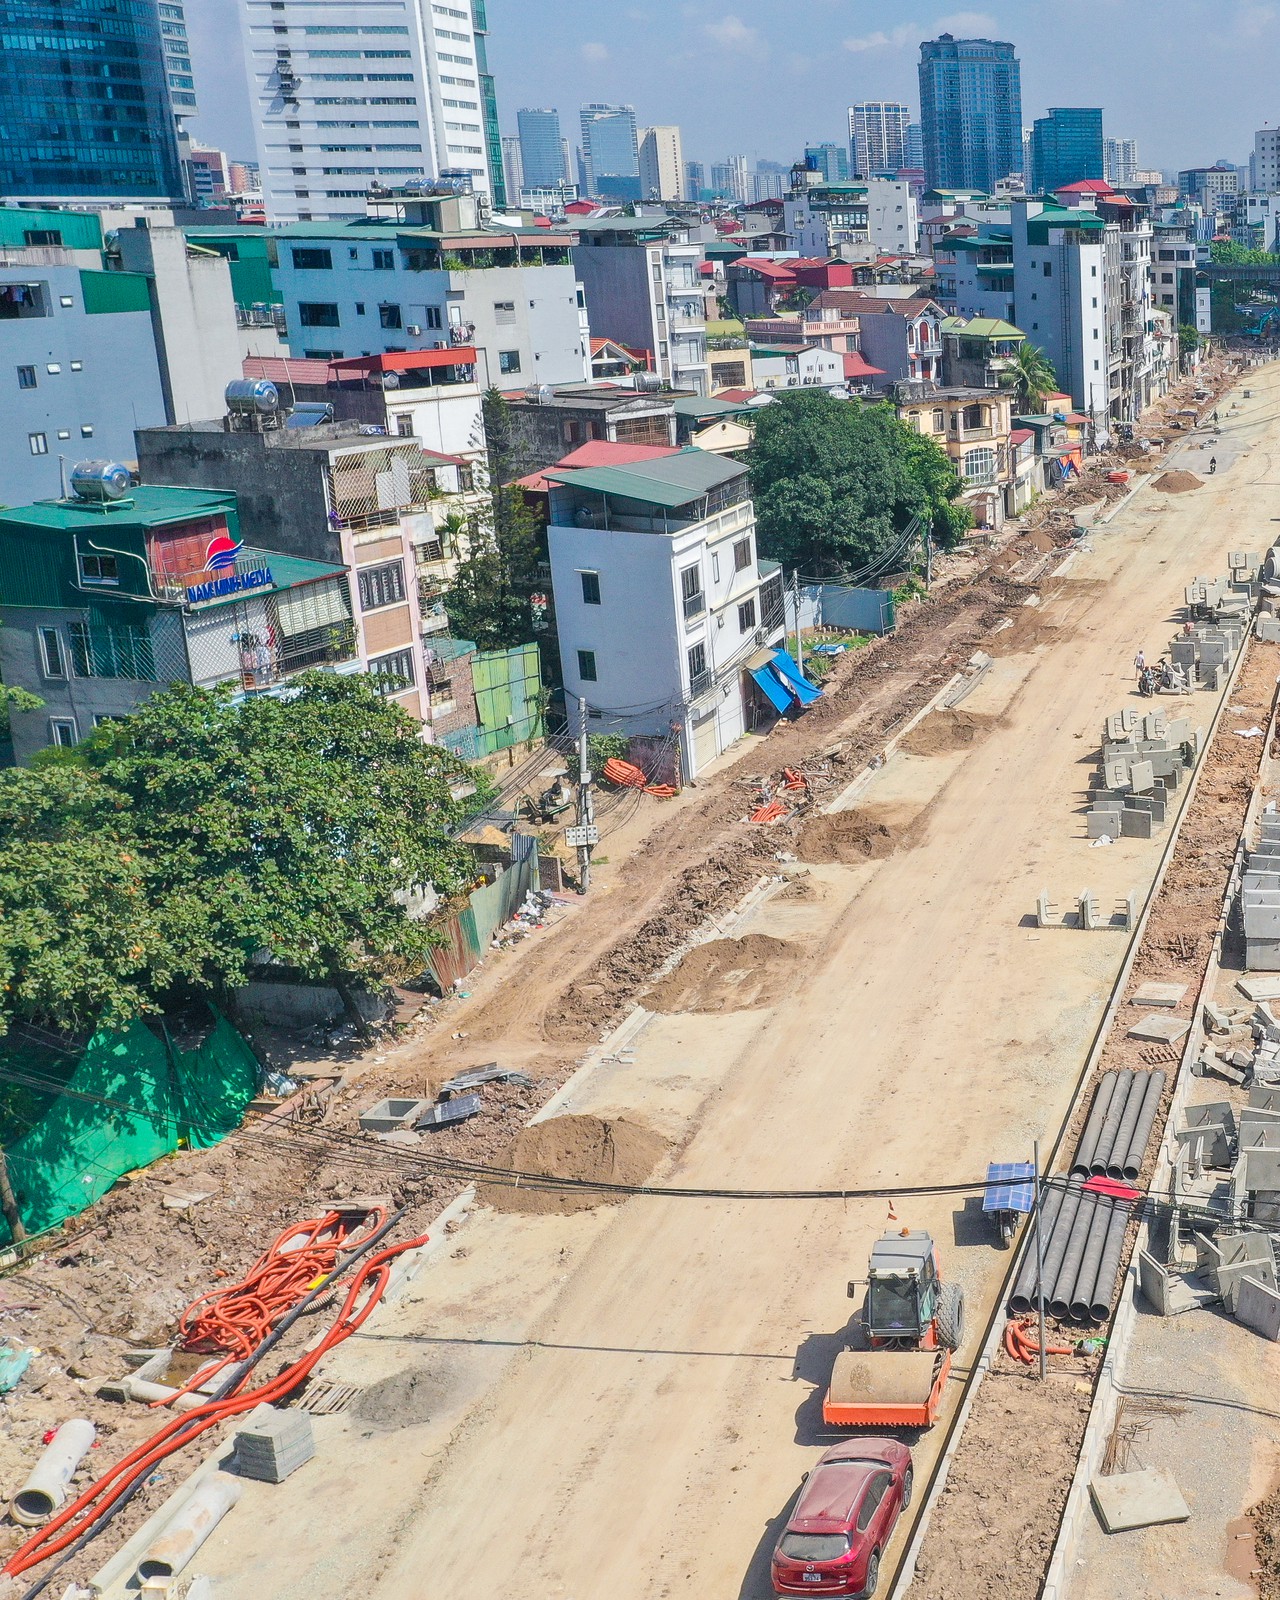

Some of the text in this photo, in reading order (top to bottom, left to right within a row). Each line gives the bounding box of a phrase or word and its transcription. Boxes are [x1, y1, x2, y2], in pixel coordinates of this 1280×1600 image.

[187, 567, 273, 603] NAM MINH MEDIA
